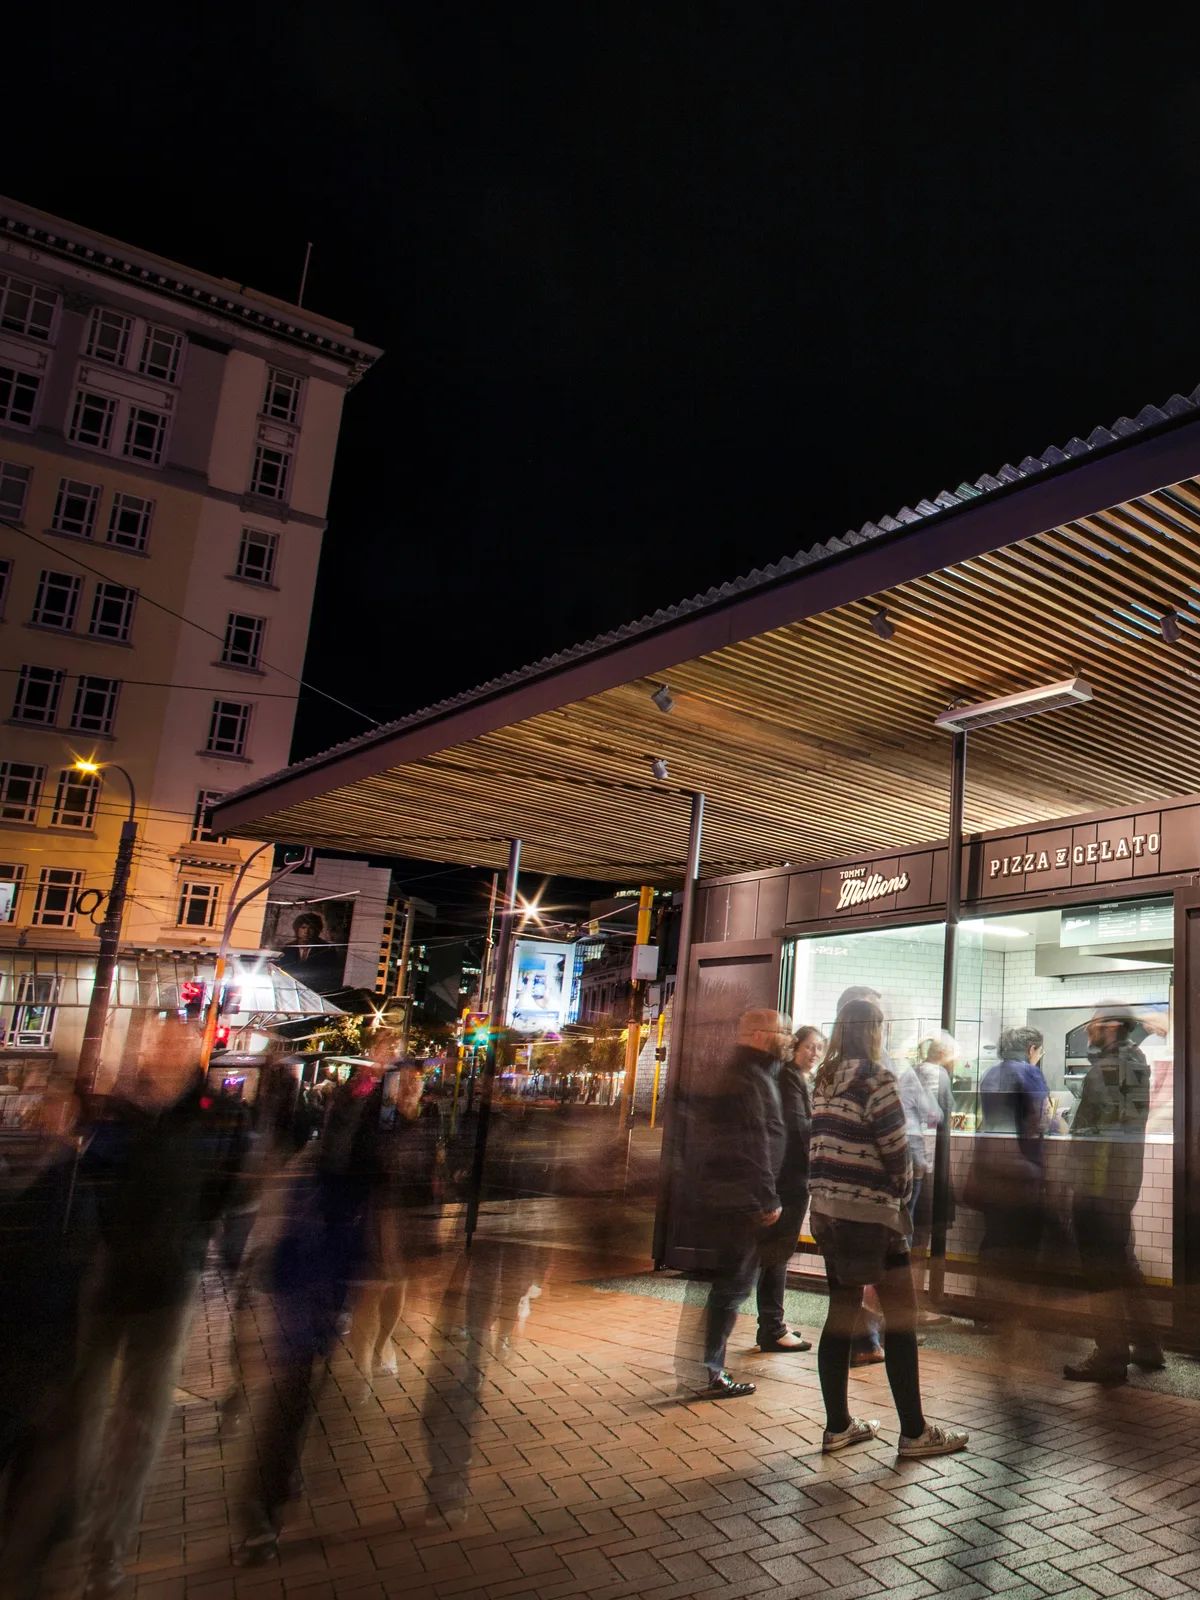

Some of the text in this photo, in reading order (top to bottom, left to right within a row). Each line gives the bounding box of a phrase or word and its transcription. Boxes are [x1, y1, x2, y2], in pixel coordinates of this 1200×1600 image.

[839, 867, 867, 880] TOMMY
[990, 833, 1160, 878] PIZZA & GELATO
[835, 872, 909, 910] Millions
